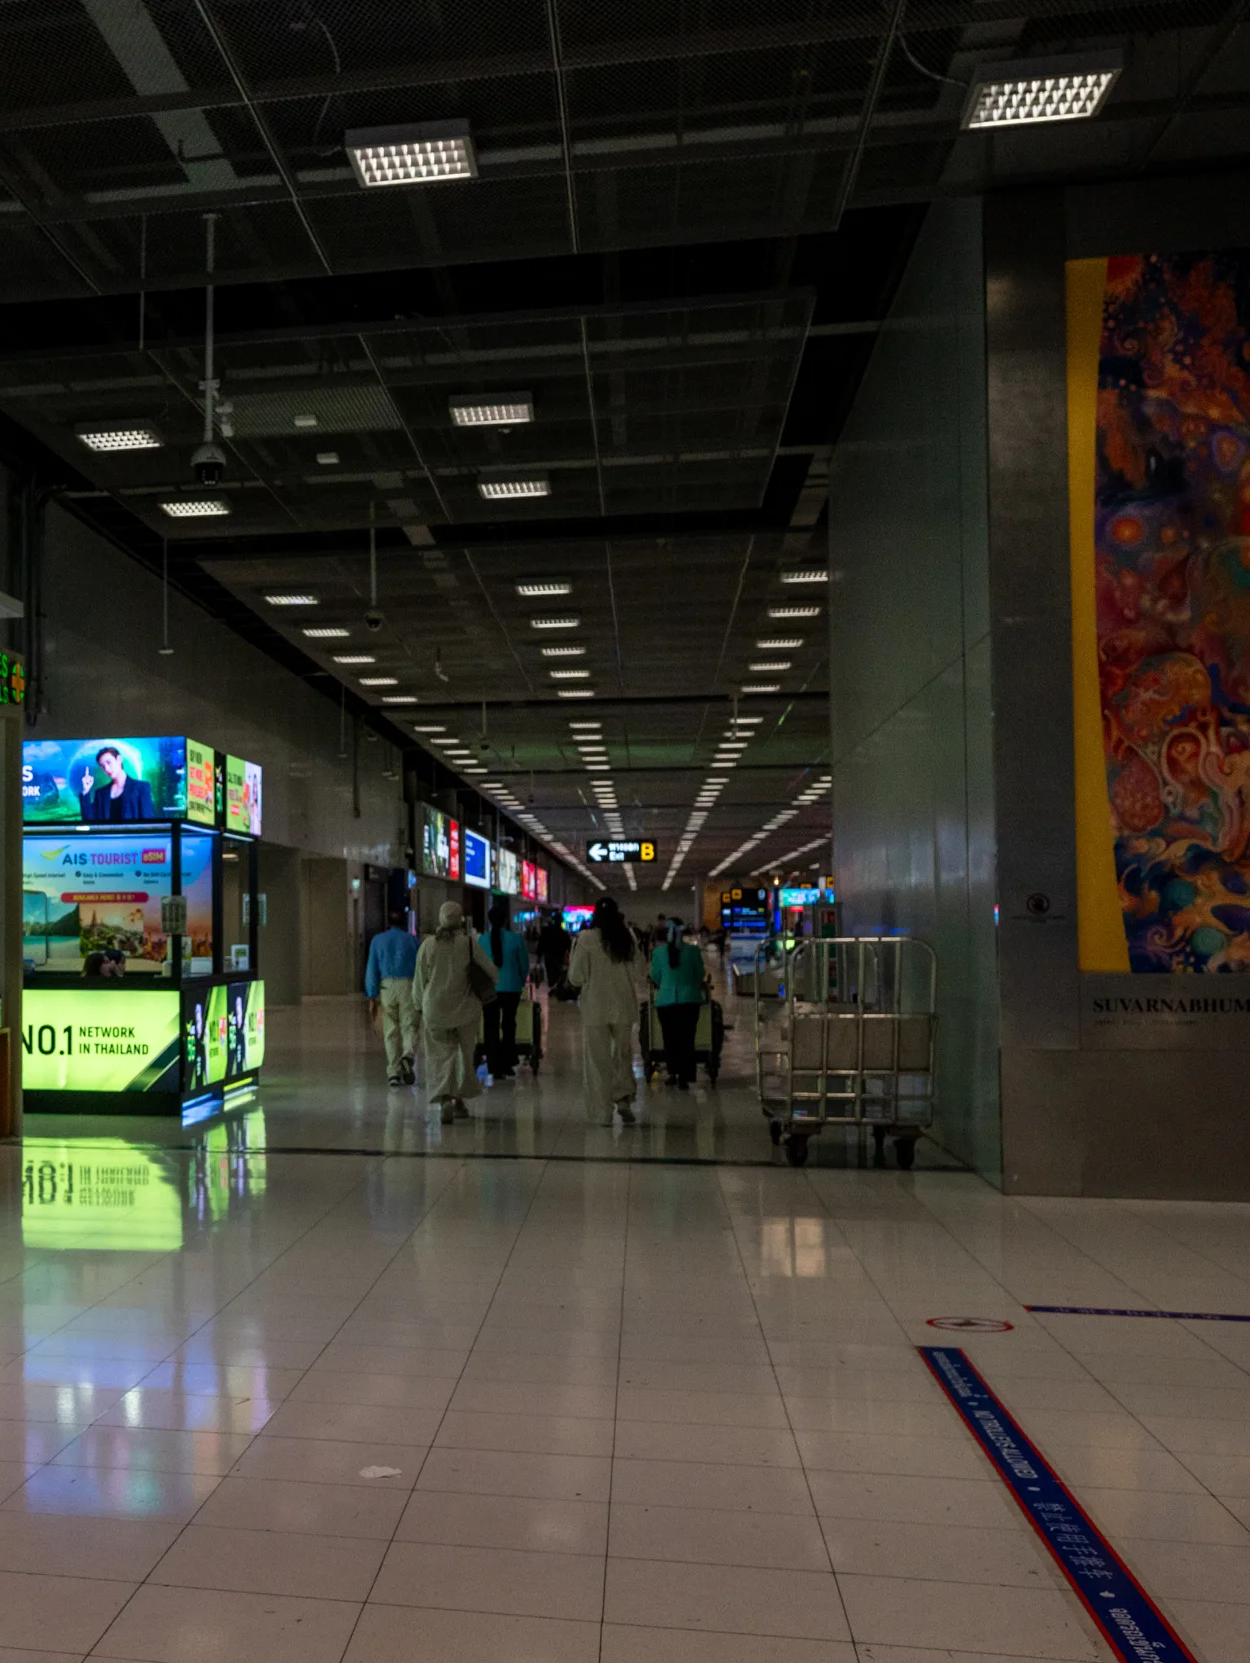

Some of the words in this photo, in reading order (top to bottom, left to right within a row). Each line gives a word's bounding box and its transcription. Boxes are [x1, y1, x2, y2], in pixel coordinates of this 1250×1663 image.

[640, 842, 655, 861] B
[62, 853, 87, 865] AIS
[90, 853, 138, 865] TOURIST
[79, 1026, 135, 1038] NETWORK
[79, 1043, 90, 1054] IN
[94, 1043, 149, 1055] THAILAND
[973, 1409, 995, 1418] NO
[1000, 1447, 1039, 1479] ALLOWED
